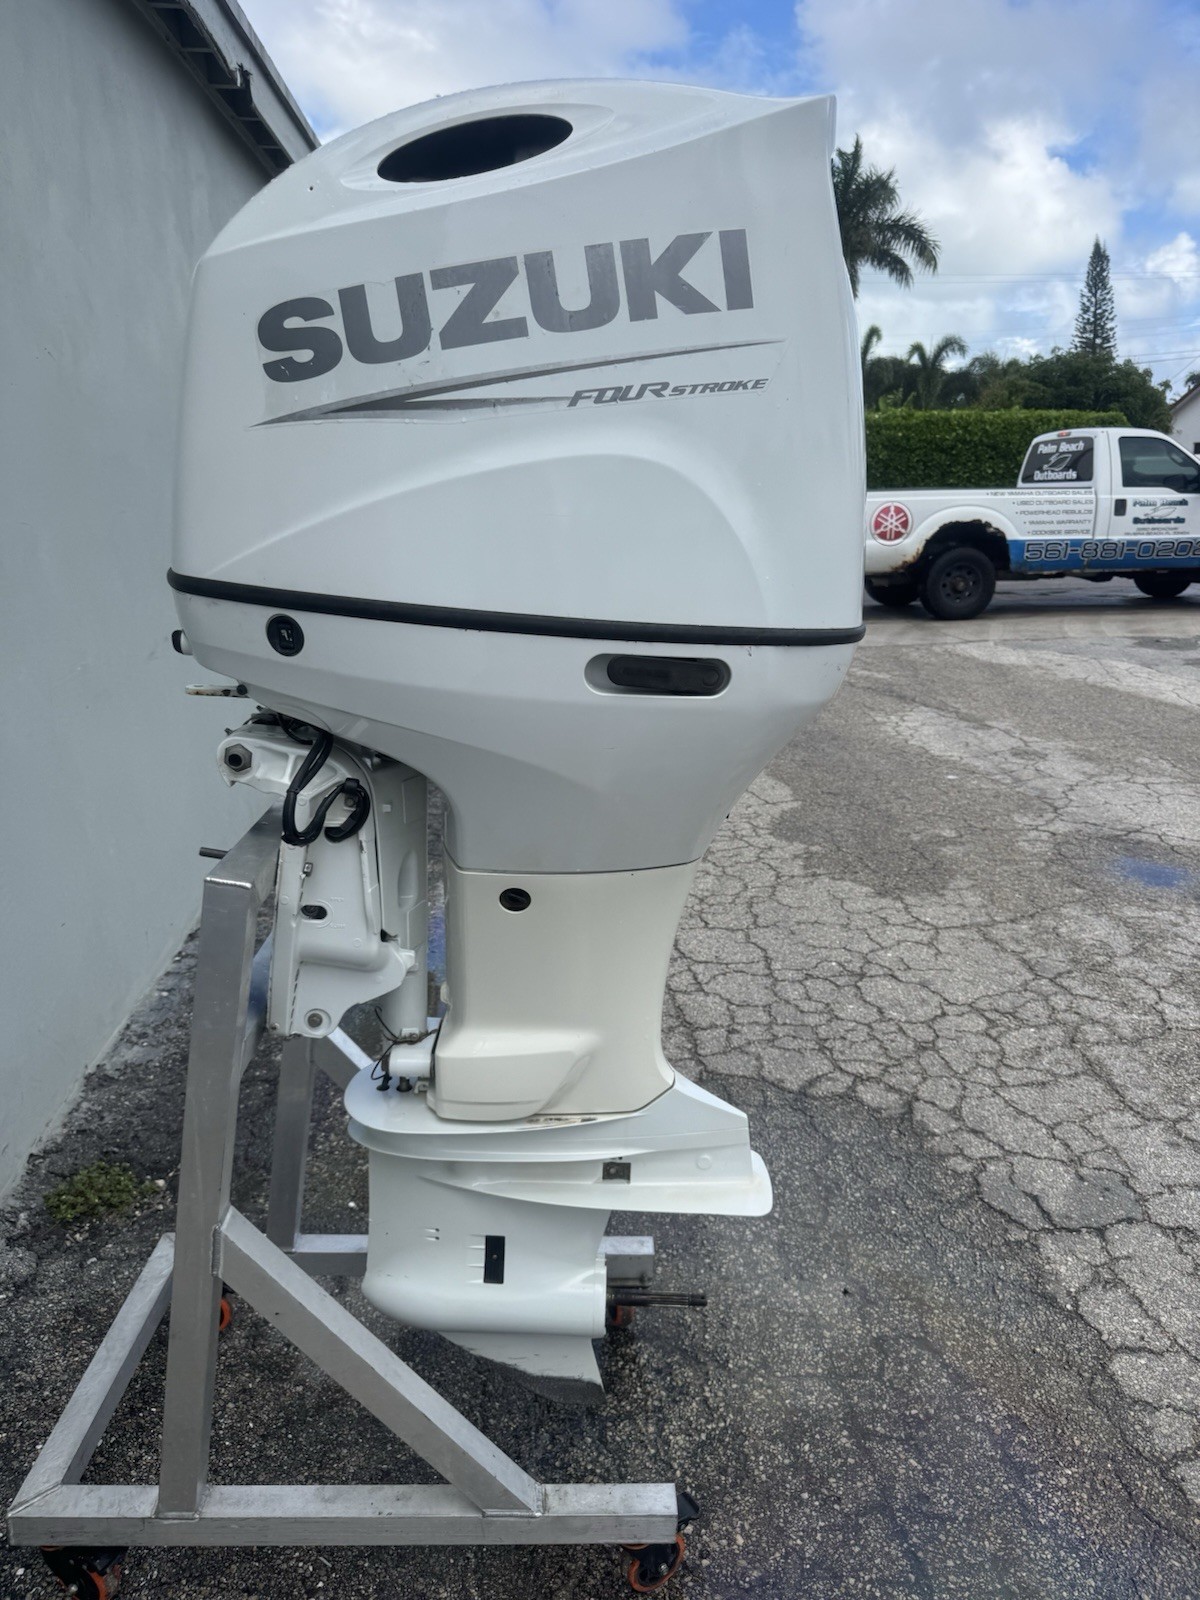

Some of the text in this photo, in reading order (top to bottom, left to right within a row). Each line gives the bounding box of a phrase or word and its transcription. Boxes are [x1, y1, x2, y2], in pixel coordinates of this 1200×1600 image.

[257, 228, 754, 383] SUZUKI
[567, 378, 769, 407] FOUR STROKE
[1037, 440, 1085, 454] Palm Beach
[1033, 469, 1078, 480] Outboards
